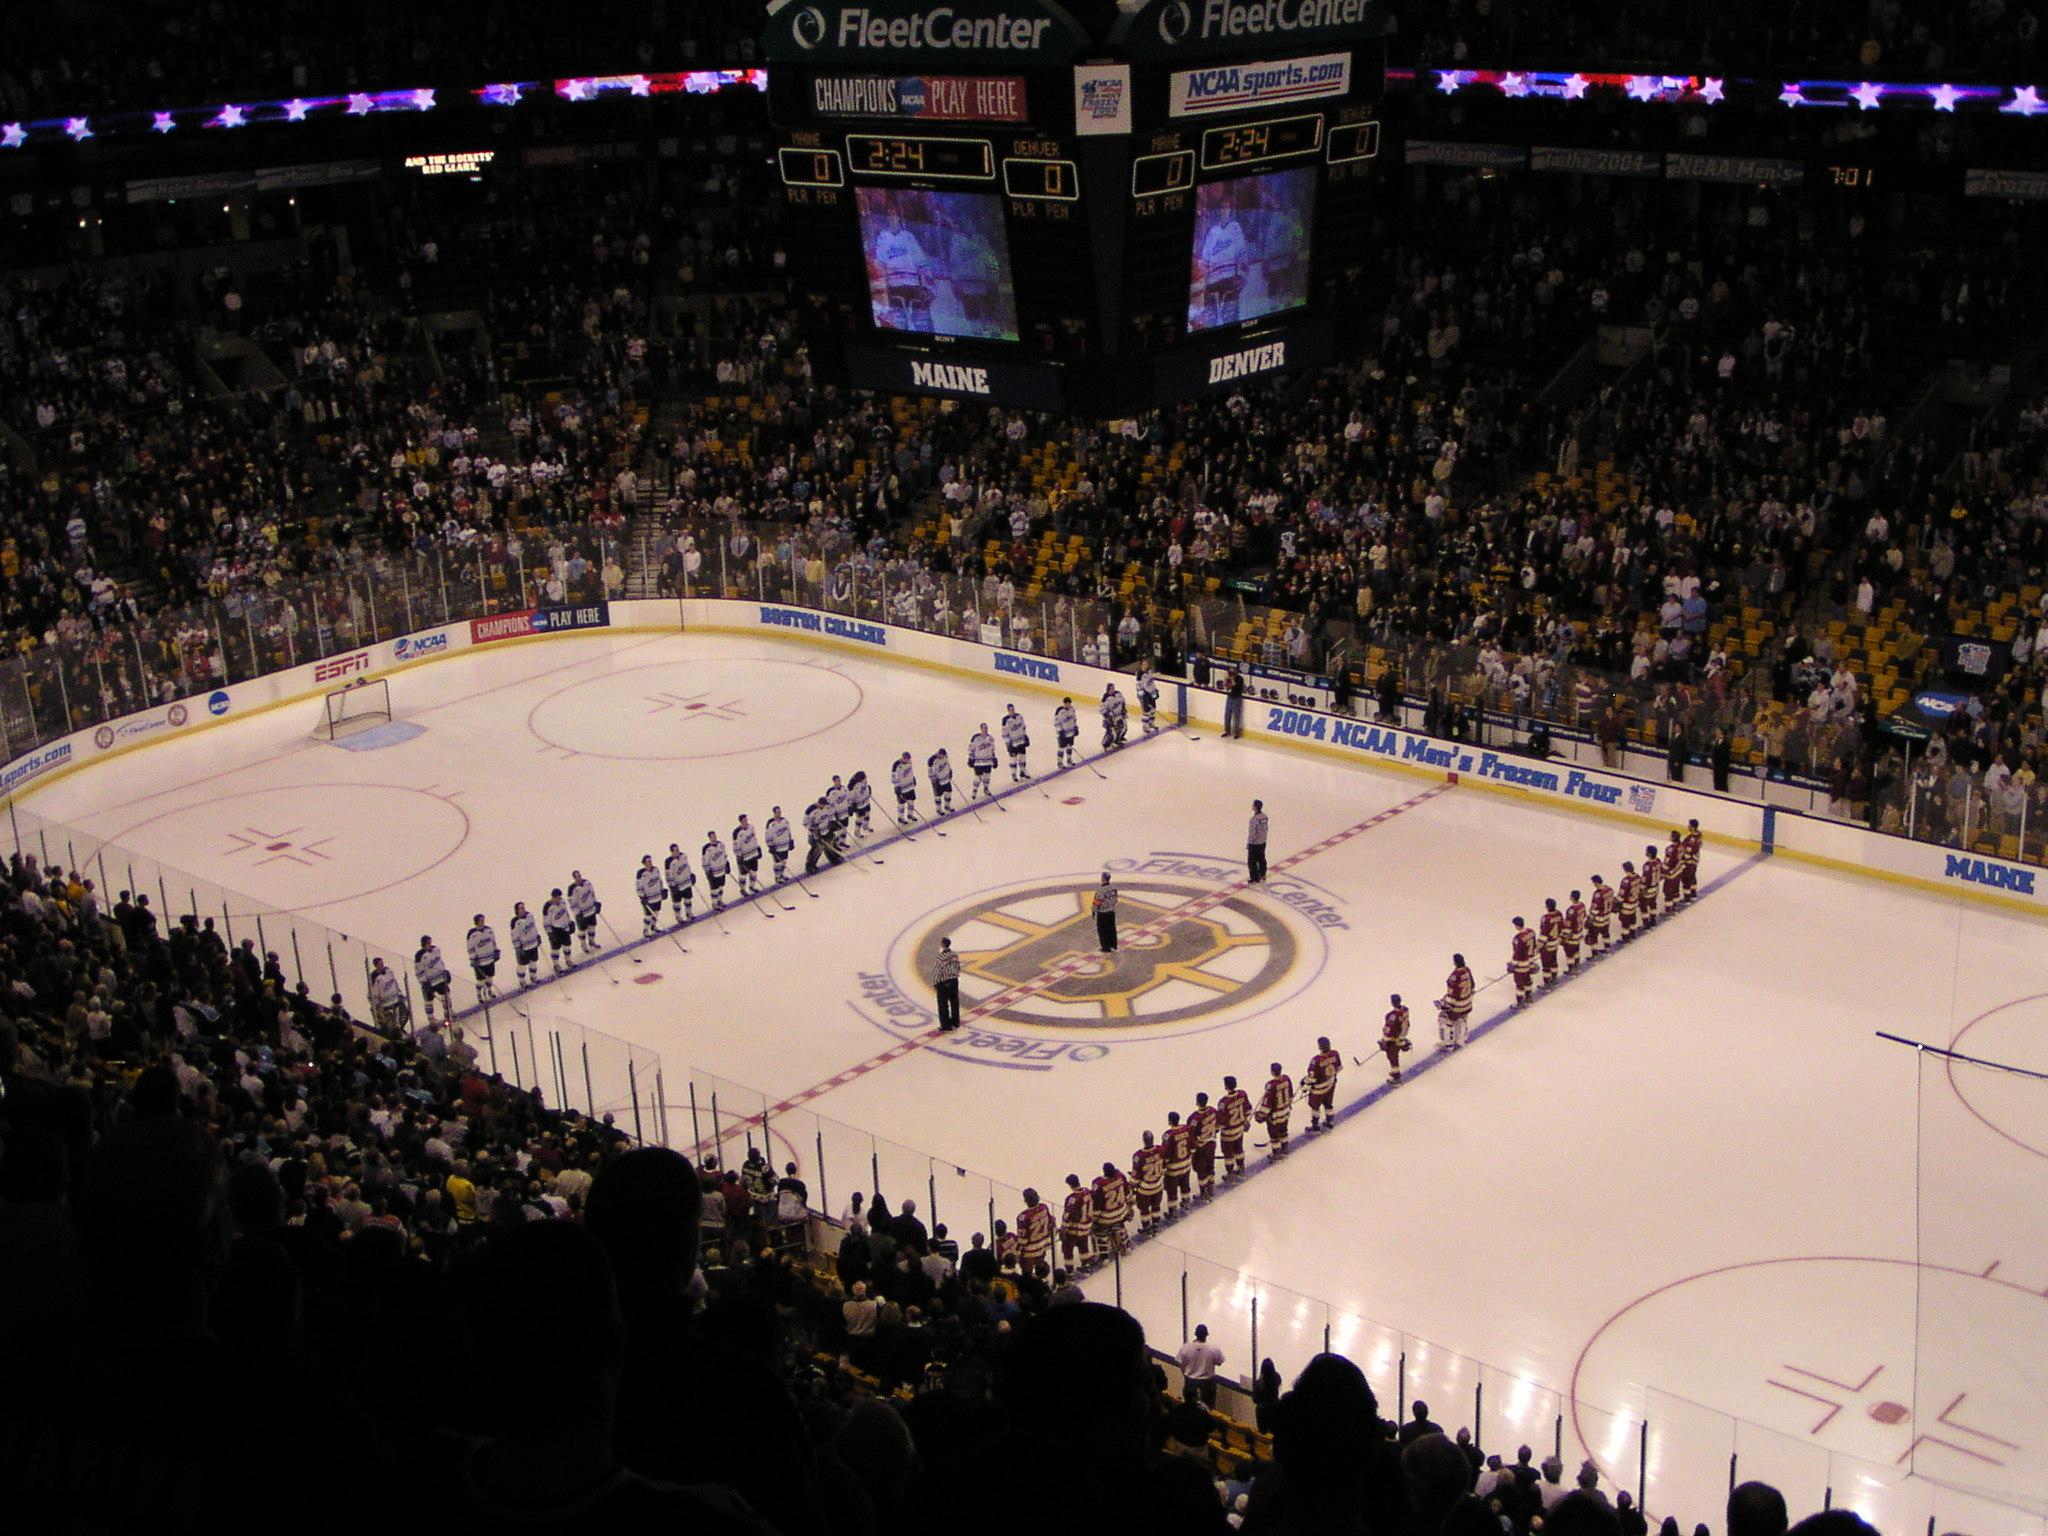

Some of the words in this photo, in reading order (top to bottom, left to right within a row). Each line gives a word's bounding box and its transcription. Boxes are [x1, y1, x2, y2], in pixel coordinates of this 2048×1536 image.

[838, 8, 1051, 49] FleetCenter
[1201, 0, 1371, 38] FleetCenter
[815, 78, 897, 113] CHAMPIONS
[931, 81, 967, 114] PLAY
[976, 81, 1018, 116] HERE
[869, 141, 924, 170] 2:24
[1220, 126, 1270, 161] 2:24
[1828, 166, 1873, 186] 7:01
[911, 361, 990, 394] MAINE
[1208, 342, 1286, 384] DENVER
[477, 617, 530, 639] CHAMPIONS
[550, 610, 572, 628] PLAY
[577, 608, 600, 625] HERE
[759, 606, 821, 633] BOSTON
[315, 652, 368, 682] ESPN
[994, 652, 1060, 683] DENVER
[0, 743, 72, 786] sports.com
[1267, 708, 1326, 740] 2004
[1331, 720, 1397, 756] NCAA
[1403, 736, 1474, 772] Men's
[1479, 752, 1559, 792] Frozen
[1565, 771, 1623, 804] Four
[1945, 854, 2035, 894] MAINE
[1136, 858, 1240, 881] Fleet
[1266, 881, 1350, 930] Center
[857, 970, 934, 1029] Center
[951, 1028, 1060, 1061] Fleet
